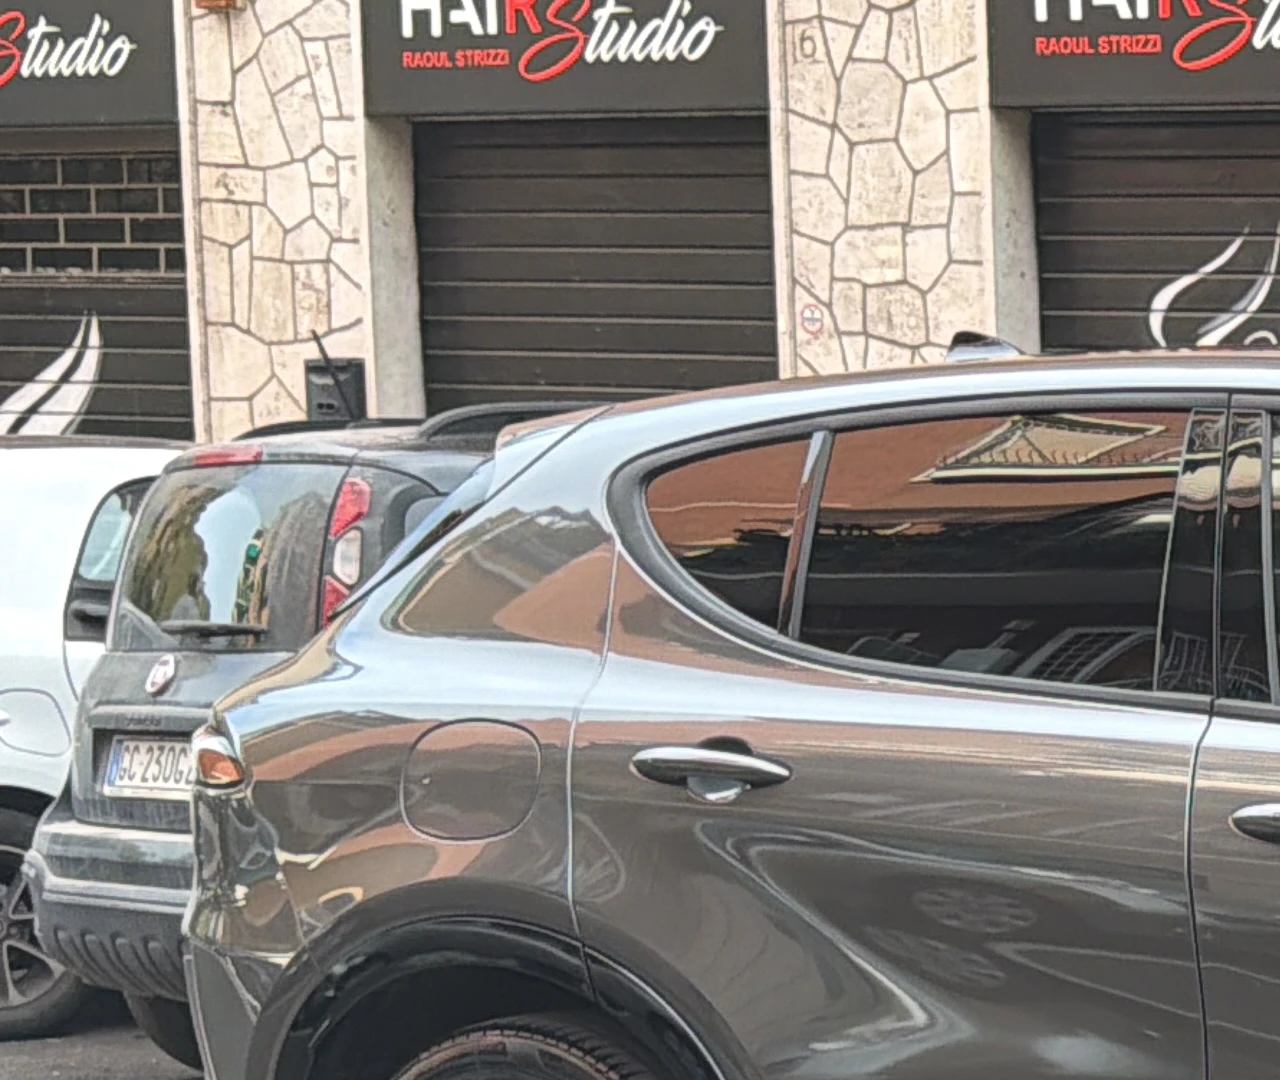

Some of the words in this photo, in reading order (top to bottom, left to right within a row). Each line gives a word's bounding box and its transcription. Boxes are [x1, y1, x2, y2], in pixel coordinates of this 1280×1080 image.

[518, 0, 725, 81] Studio
[1035, 37, 1094, 56] RAOUL
[1097, 34, 1162, 54] STRIZZI
[402, 51, 453, 68] RAOUL
[455, 48, 509, 67] STRIZZI
